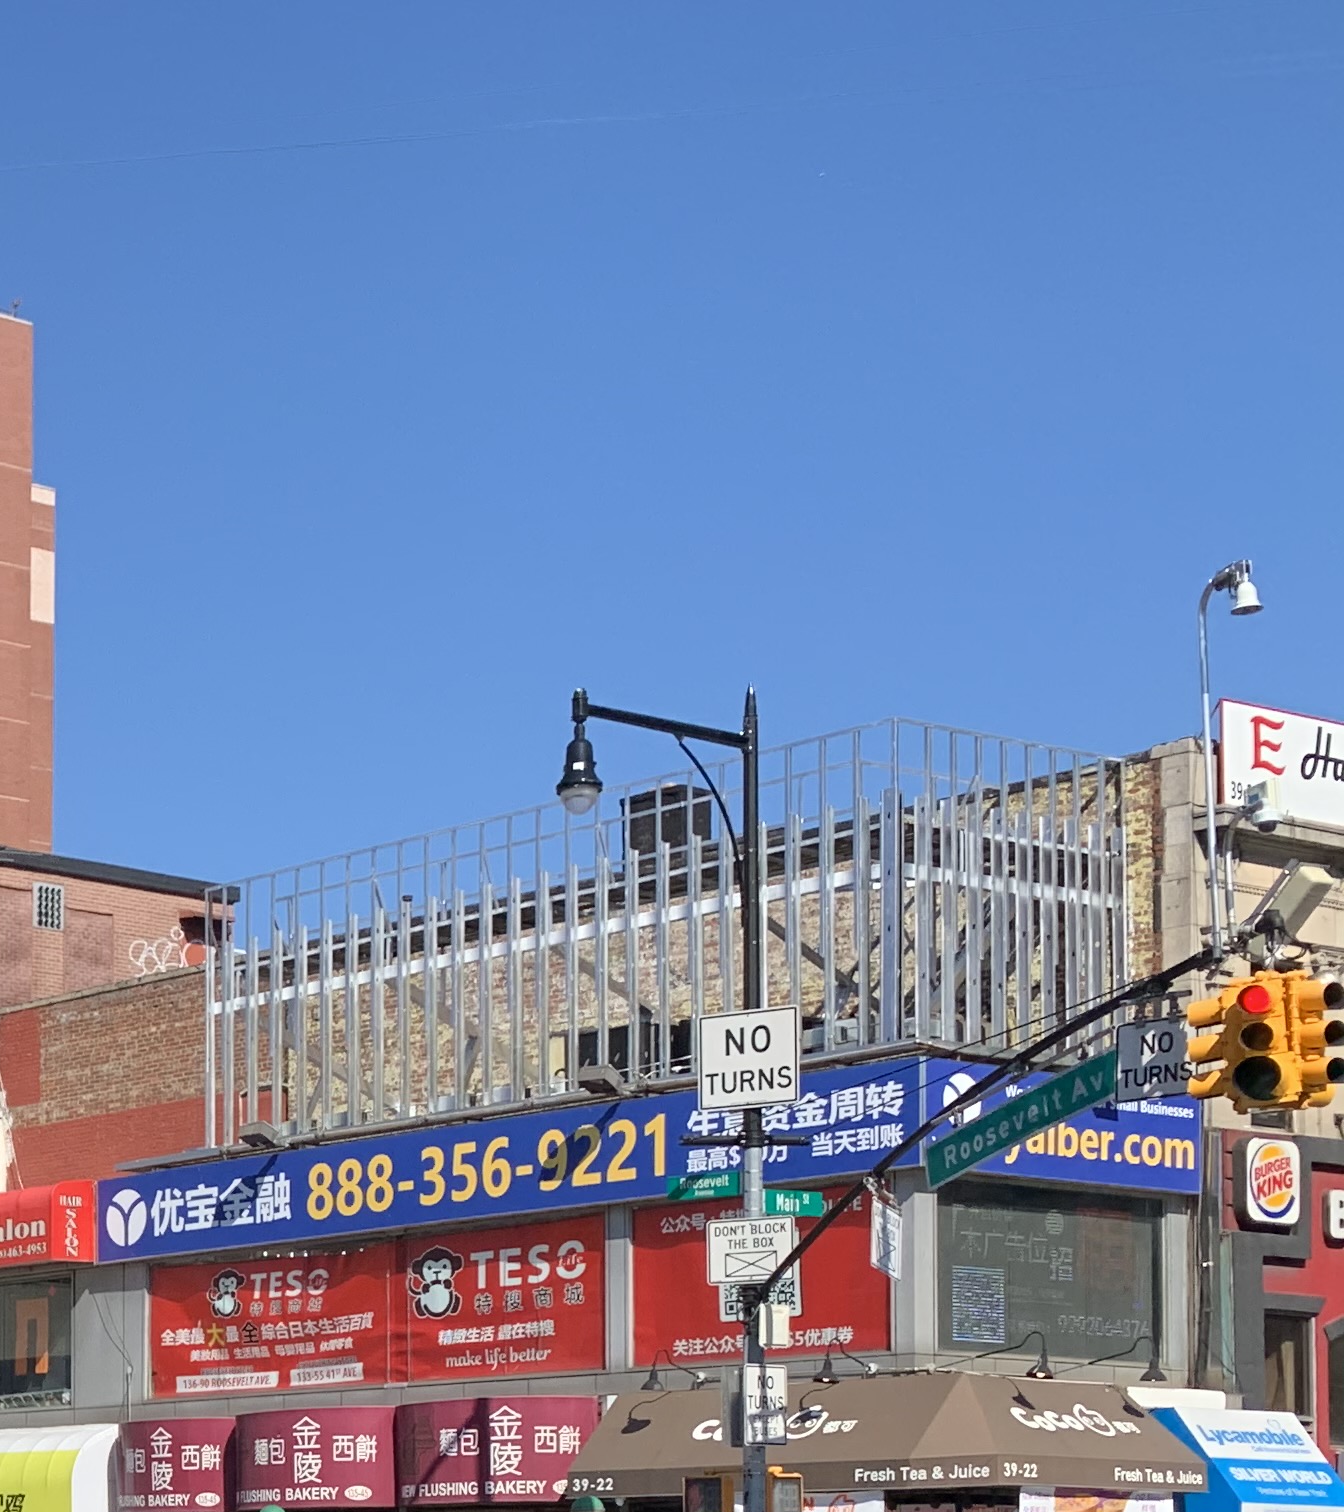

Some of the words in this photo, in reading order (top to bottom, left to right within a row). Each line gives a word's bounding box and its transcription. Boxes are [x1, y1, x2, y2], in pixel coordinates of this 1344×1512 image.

[1250, 716, 1287, 776] E
[725, 1025, 771, 1056] NO
[1140, 1031, 1174, 1055] NO
[705, 1065, 792, 1096] TURNS
[1120, 1061, 1192, 1089] TURNS
[943, 1088, 1062, 1169] Roosevelt
[1072, 1069, 1105, 1104] Av
[1140, 1101, 1194, 1119] Businesses
[811, 1123, 904, 1158] 当天到账
[307, 1113, 667, 1221] 888-356-9221
[1254, 1157, 1291, 1181] BURGER
[679, 1173, 730, 1190] Roosevelt
[1256, 1172, 1293, 1200] KING
[59, 1195, 83, 1208] HAIR
[150, 1172, 292, 1237] 优宝金融
[776, 1193, 801, 1212] Main
[803, 1193, 810, 1205] St
[64, 1208, 79, 1257] SALON
[715, 1226, 746, 1237] DON'T
[751, 1222, 787, 1235] BLOCK
[728, 1238, 749, 1250] THE
[753, 1237, 774, 1249] BOX
[469, 1240, 587, 1290] TESO
[250, 1267, 330, 1300] TESO
[474, 1282, 585, 1316] 特搜商城
[445, 1350, 483, 1368] make
[485, 1346, 507, 1371] life
[509, 1346, 552, 1365] better
[757, 1375, 775, 1390] NO
[747, 1395, 785, 1411] TURNS
[1010, 1405, 1085, 1432] CoCo
[332, 1434, 377, 1463] 西餅
[439, 1427, 479, 1457] 麵包
[489, 1405, 522, 1477] 金陵
[534, 1426, 581, 1455] 西餅
[1196, 1424, 1305, 1446] Lycamobile
[150, 1427, 173, 1491] 金陵
[181, 1444, 221, 1471] 西餅
[254, 1437, 285, 1466] 麵包
[292, 1416, 322, 1484] 金陵
[854, 1467, 895, 1483] Fresh
[900, 1466, 927, 1482] Tea
[932, 1466, 944, 1480] &
[948, 1464, 990, 1480] Juice
[1003, 1462, 1039, 1479] 39-22
[1114, 1467, 1143, 1484] Fresh
[1144, 1468, 1163, 1484] Tea
[1166, 1470, 1175, 1484] &
[1177, 1470, 1203, 1486] Juice
[1228, 1466, 1282, 1484] SILVER
[1278, 1469, 1333, 1486] WORLD
[240, 1488, 281, 1503] FLUSHING
[285, 1486, 339, 1502] BAKERY
[418, 1482, 479, 1498] FLUSHING
[484, 1480, 547, 1495] BAKERY
[571, 1477, 614, 1492] 39-22
[148, 1494, 190, 1507] BAKERY
